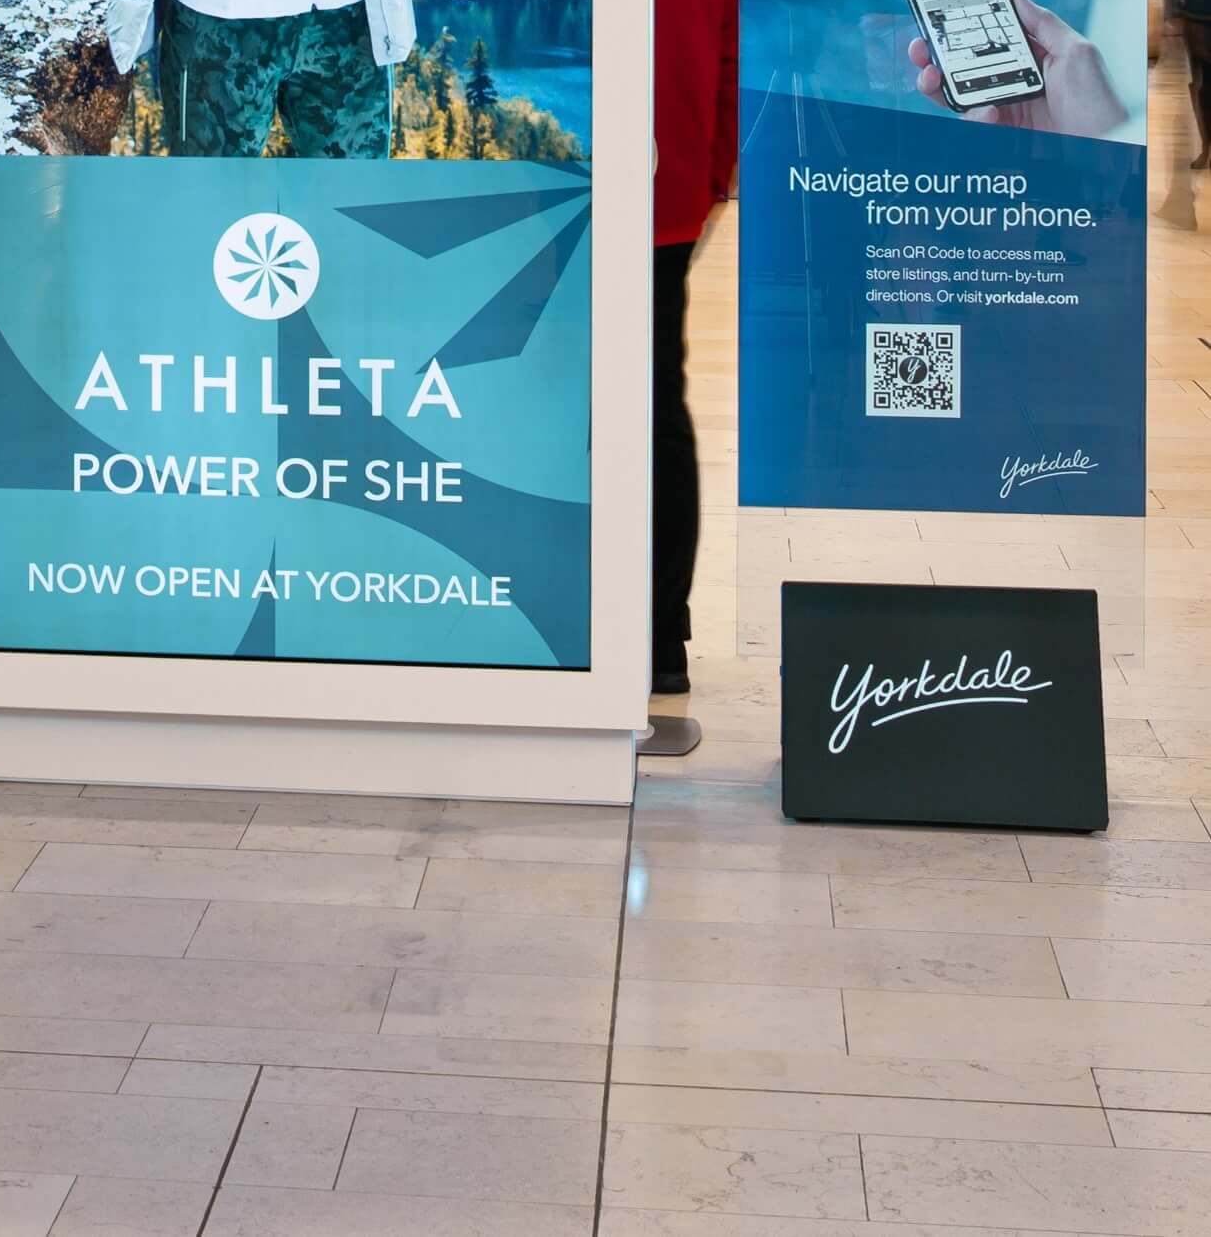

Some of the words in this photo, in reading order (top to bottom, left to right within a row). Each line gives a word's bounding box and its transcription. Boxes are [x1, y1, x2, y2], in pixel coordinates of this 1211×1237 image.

[790, 167, 909, 197] Navigate
[915, 174, 961, 193] our
[967, 175, 1027, 199] map
[866, 199, 929, 225] from
[935, 206, 997, 231] your
[1003, 201, 1097, 231] phone.
[866, 245, 901, 258] Scan
[902, 245, 925, 259] QR
[927, 246, 965, 259] Code
[967, 248, 981, 260] to
[983, 249, 1032, 260] access
[1033, 250, 1066, 263] map,
[866, 268, 901, 280] store
[902, 268, 951, 283] listings,
[953, 271, 979, 281] and
[866, 289, 934, 302] directions.
[936, 289, 955, 303] Or
[956, 291, 982, 303] visit
[984, 291, 1079, 306] yorkdale.com
[75, 351, 461, 418] ATHLETA
[74, 453, 260, 497] POWER
[275, 458, 348, 499] OF
[365, 460, 462, 502] SHE
[999, 449, 1099, 499] Yorkdale
[29, 563, 126, 594] NOW
[135, 566, 240, 598] OPEN
[251, 569, 298, 599] AT
[306, 571, 511, 606] YORKDALE
[828, 649, 1053, 754] Yorkdale
